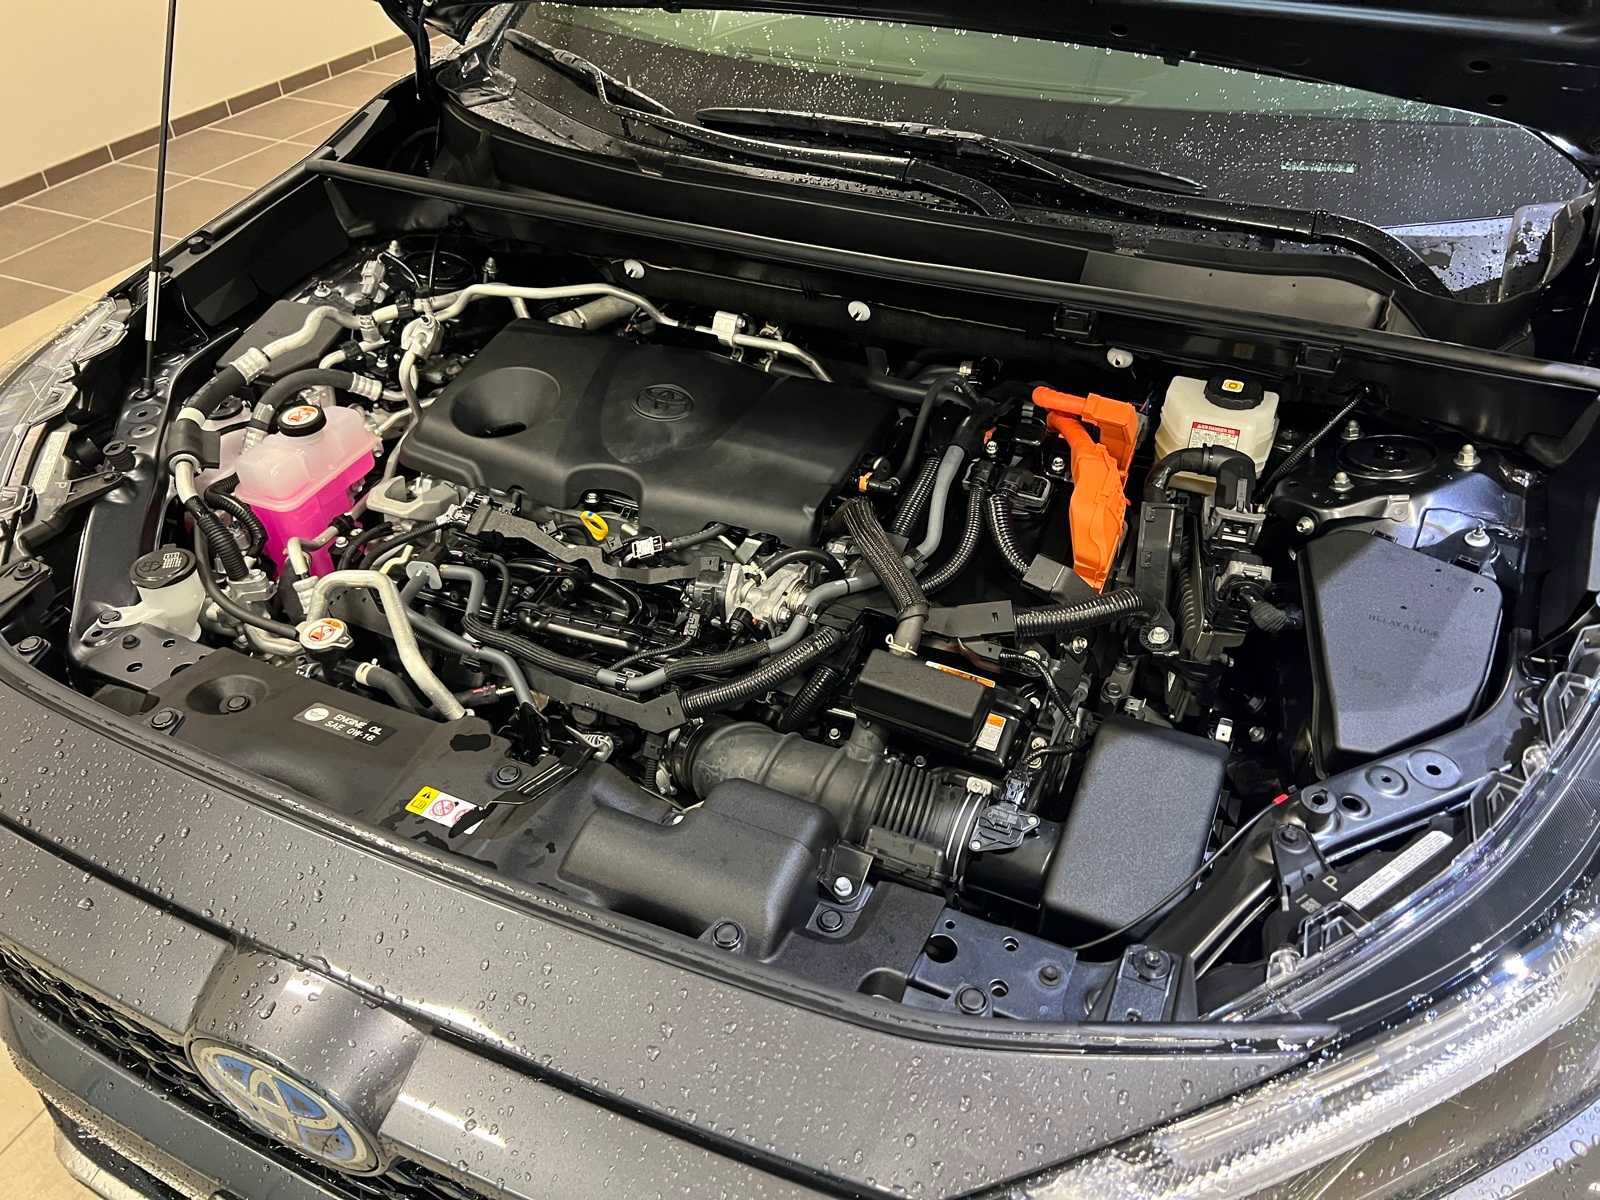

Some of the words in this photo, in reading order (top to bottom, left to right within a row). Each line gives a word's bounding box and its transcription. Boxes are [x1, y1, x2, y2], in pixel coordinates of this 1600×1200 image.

[324, 720, 345, 731] SAE
[346, 728, 376, 741] 0W-16
[333, 714, 367, 729] ENGINE
[368, 726, 383, 735] OIL
[1322, 875, 1338, 892] P
